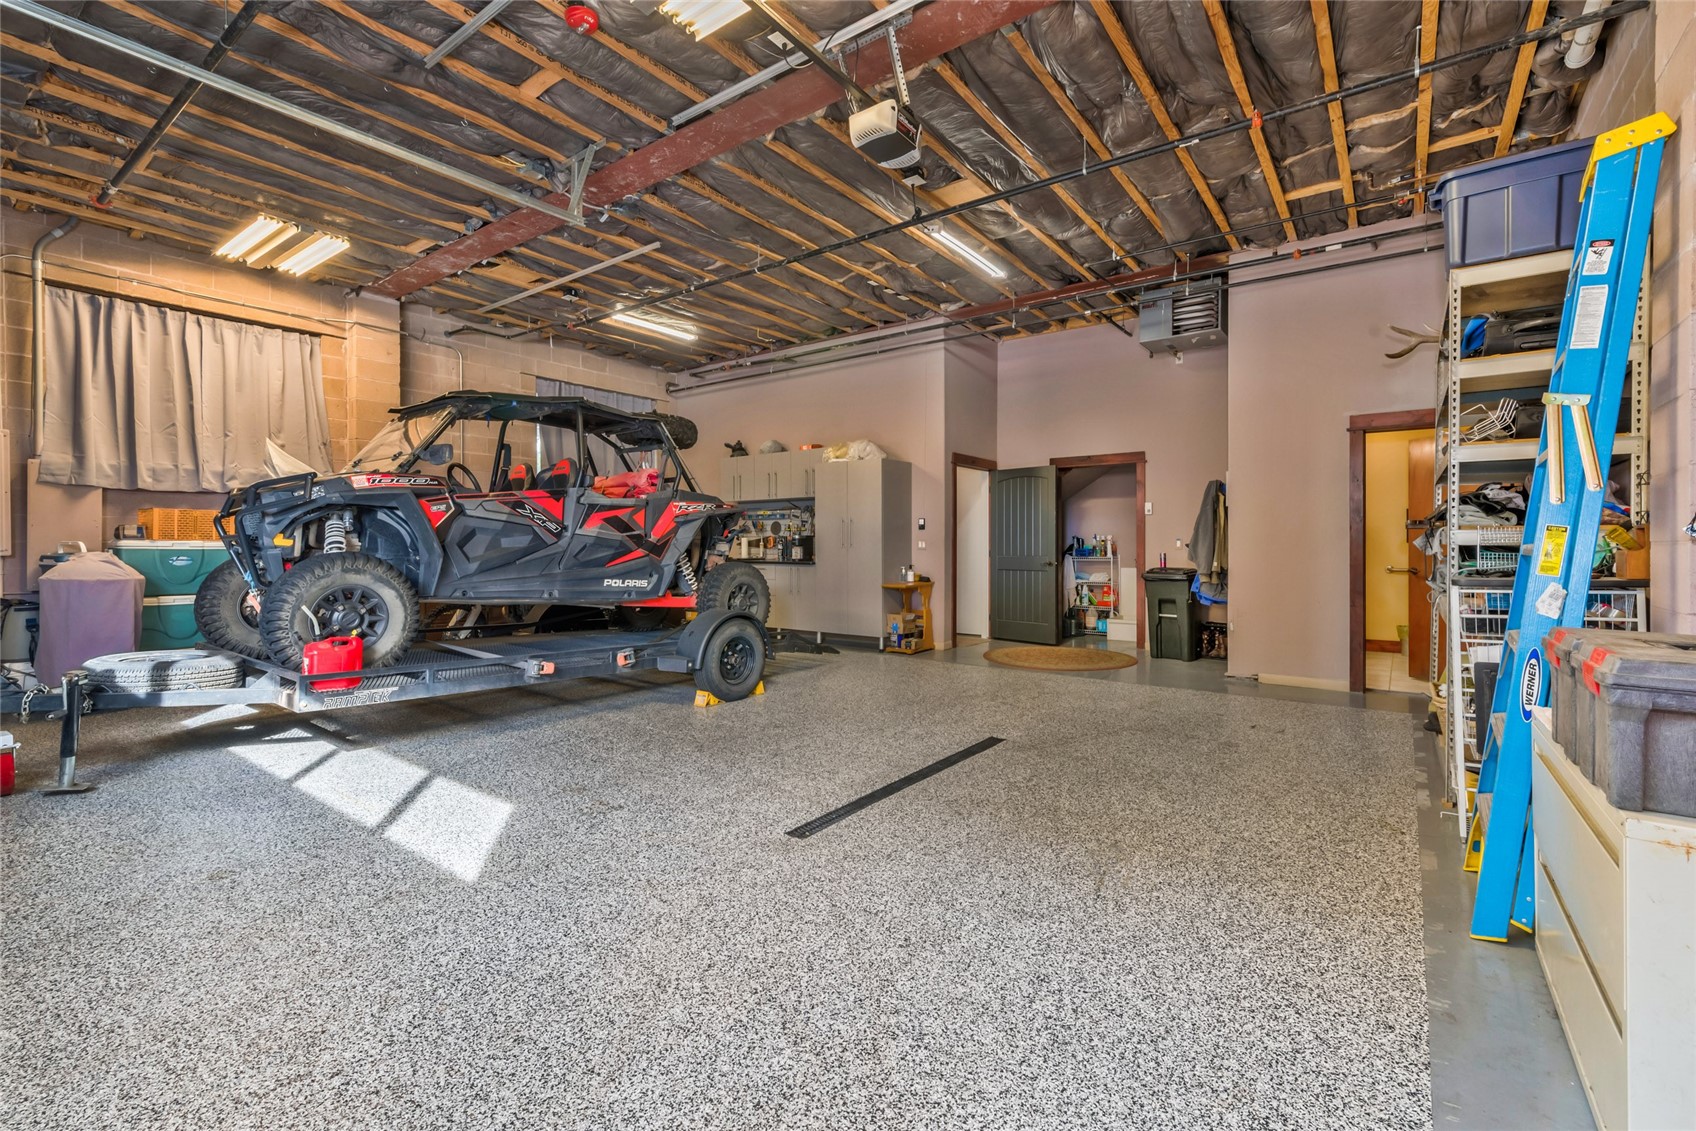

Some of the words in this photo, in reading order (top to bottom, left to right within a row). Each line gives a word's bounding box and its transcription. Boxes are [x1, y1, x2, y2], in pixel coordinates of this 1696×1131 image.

[370, 477, 430, 486] 1000
[603, 578, 648, 588] POLARIS
[1525, 662, 1537, 706] WERNER
